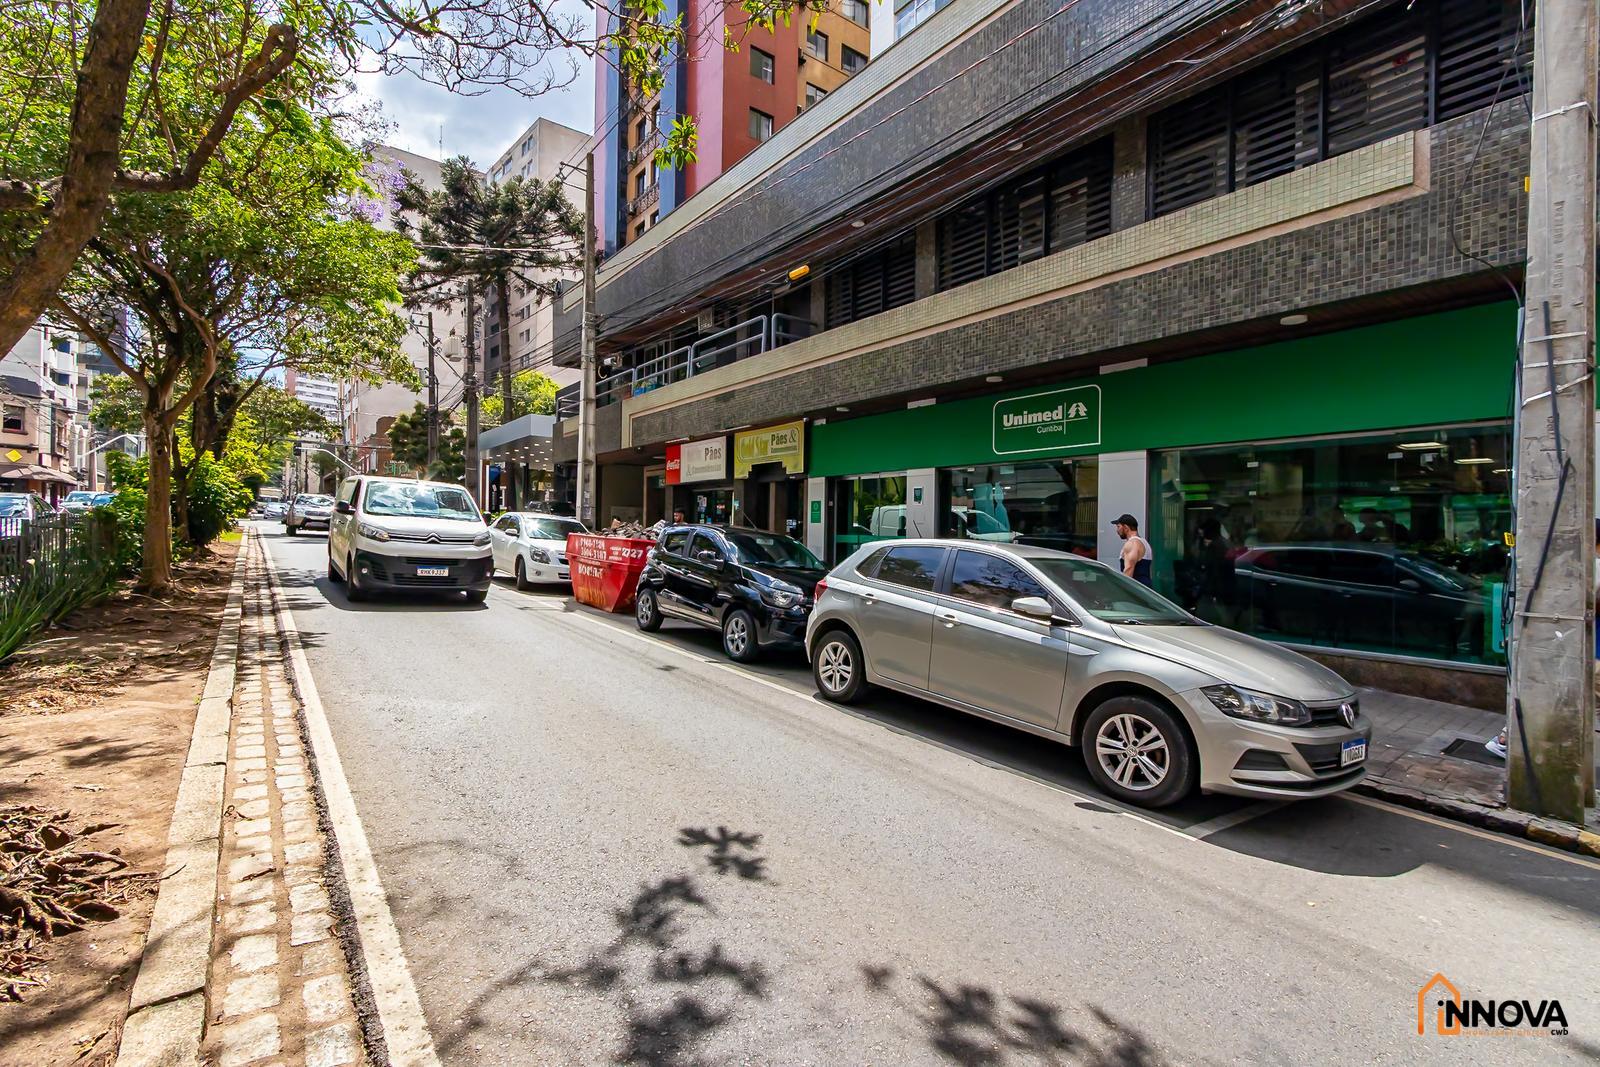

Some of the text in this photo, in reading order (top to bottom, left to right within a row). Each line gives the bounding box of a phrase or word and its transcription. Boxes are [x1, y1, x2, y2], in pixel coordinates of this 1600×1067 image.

[1002, 405, 1063, 427] Unimed
[1036, 424, 1064, 434] Curitiba
[770, 433, 788, 446] Pães
[704, 446, 721, 461] Pães
